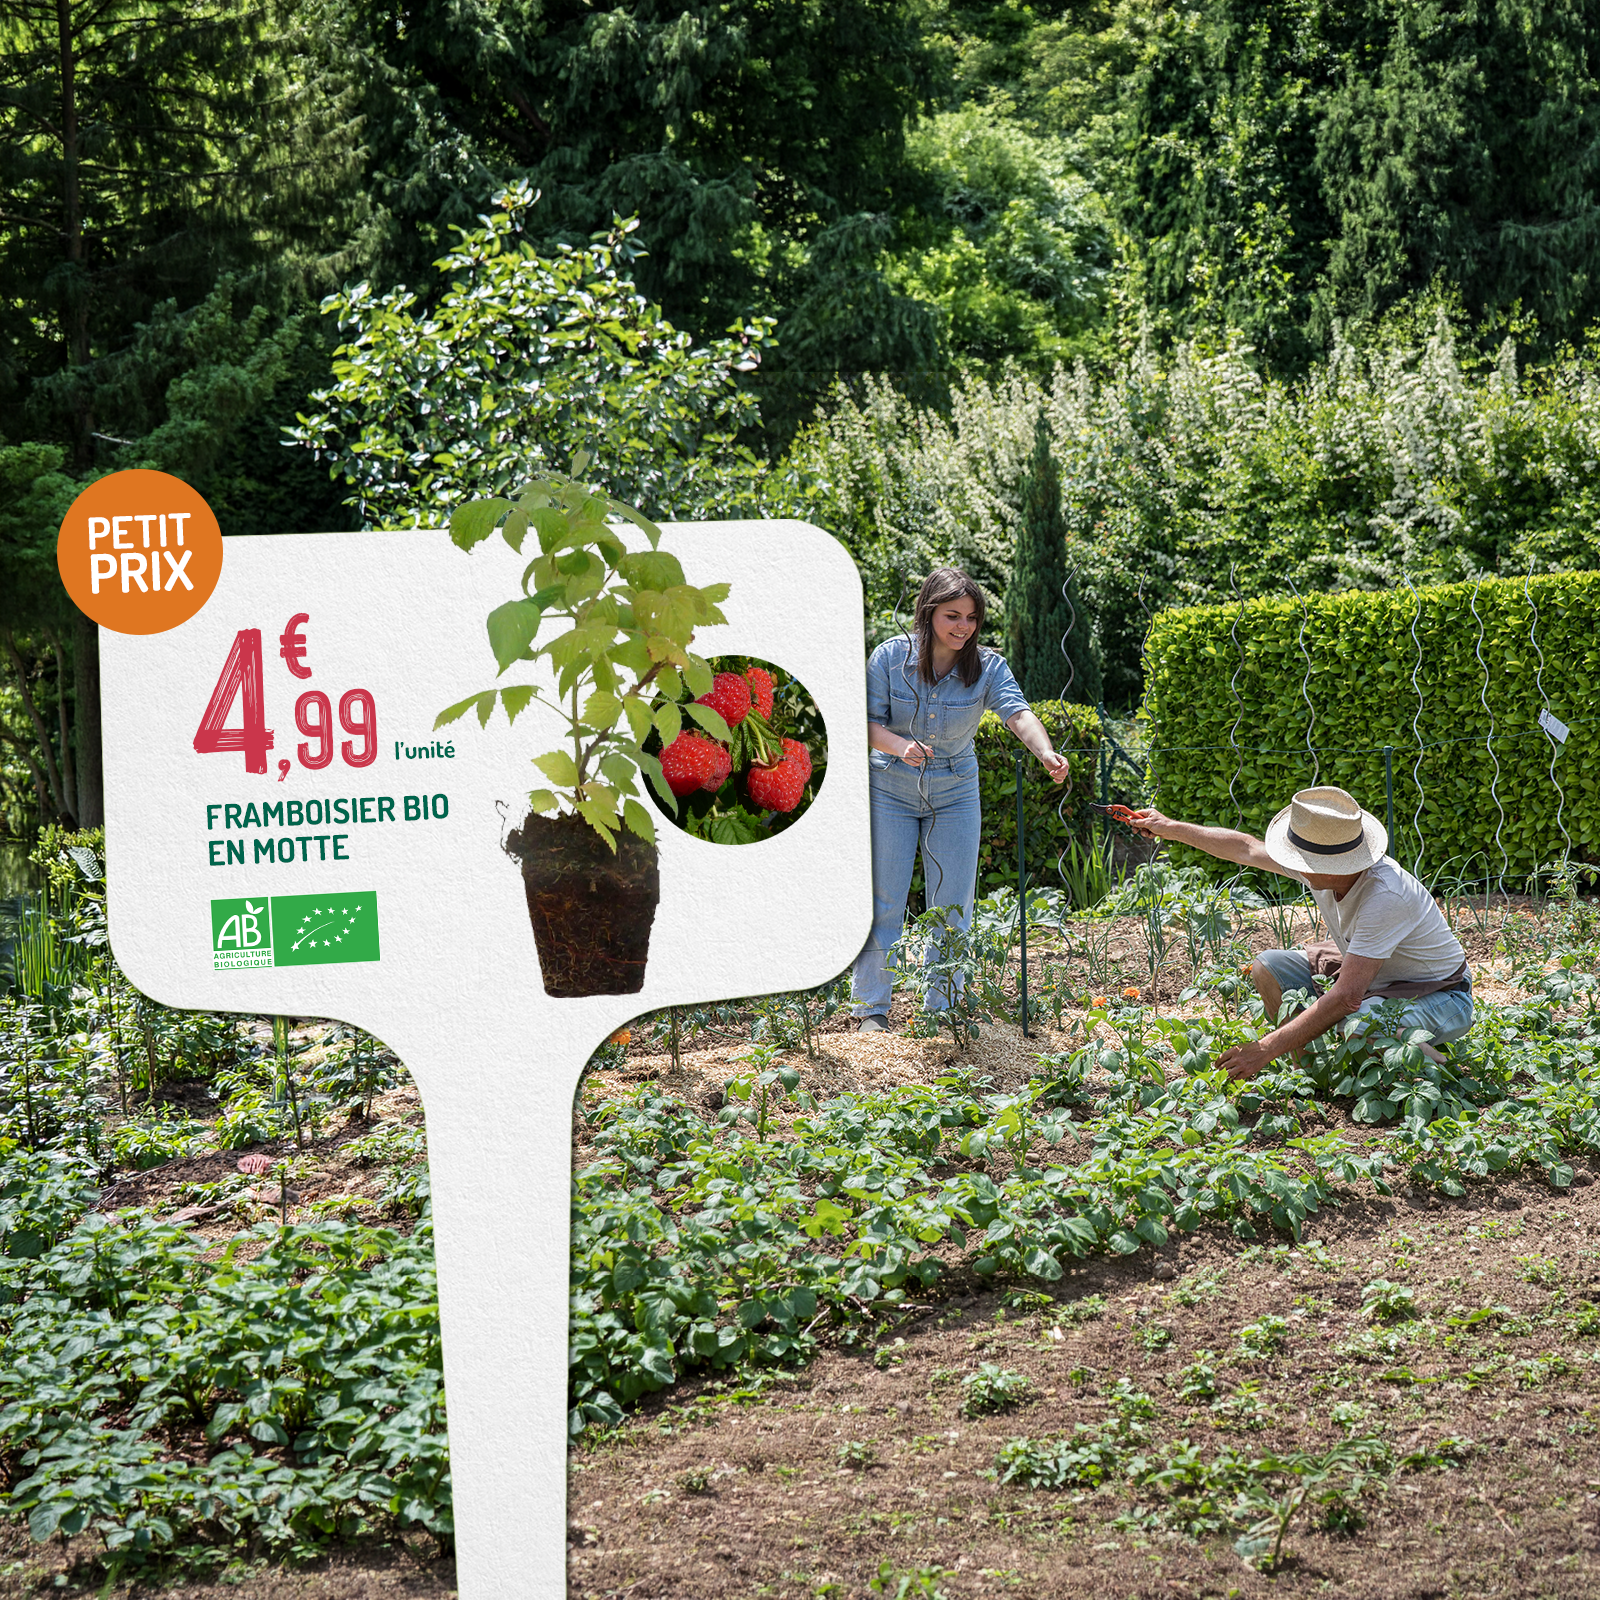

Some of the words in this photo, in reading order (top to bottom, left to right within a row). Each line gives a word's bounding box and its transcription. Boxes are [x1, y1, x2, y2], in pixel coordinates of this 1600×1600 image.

[87, 512, 192, 551] PETIT
[90, 549, 195, 595] PRIX
[206, 796, 397, 831] FRAMBOISIER
[403, 793, 450, 822] BIO
[208, 839, 246, 867] EN
[253, 834, 351, 865] MOTTE
[217, 913, 262, 949] AB
[213, 950, 272, 960] AGRICULTURE
[213, 958, 273, 969] BIOLOGIQUE
